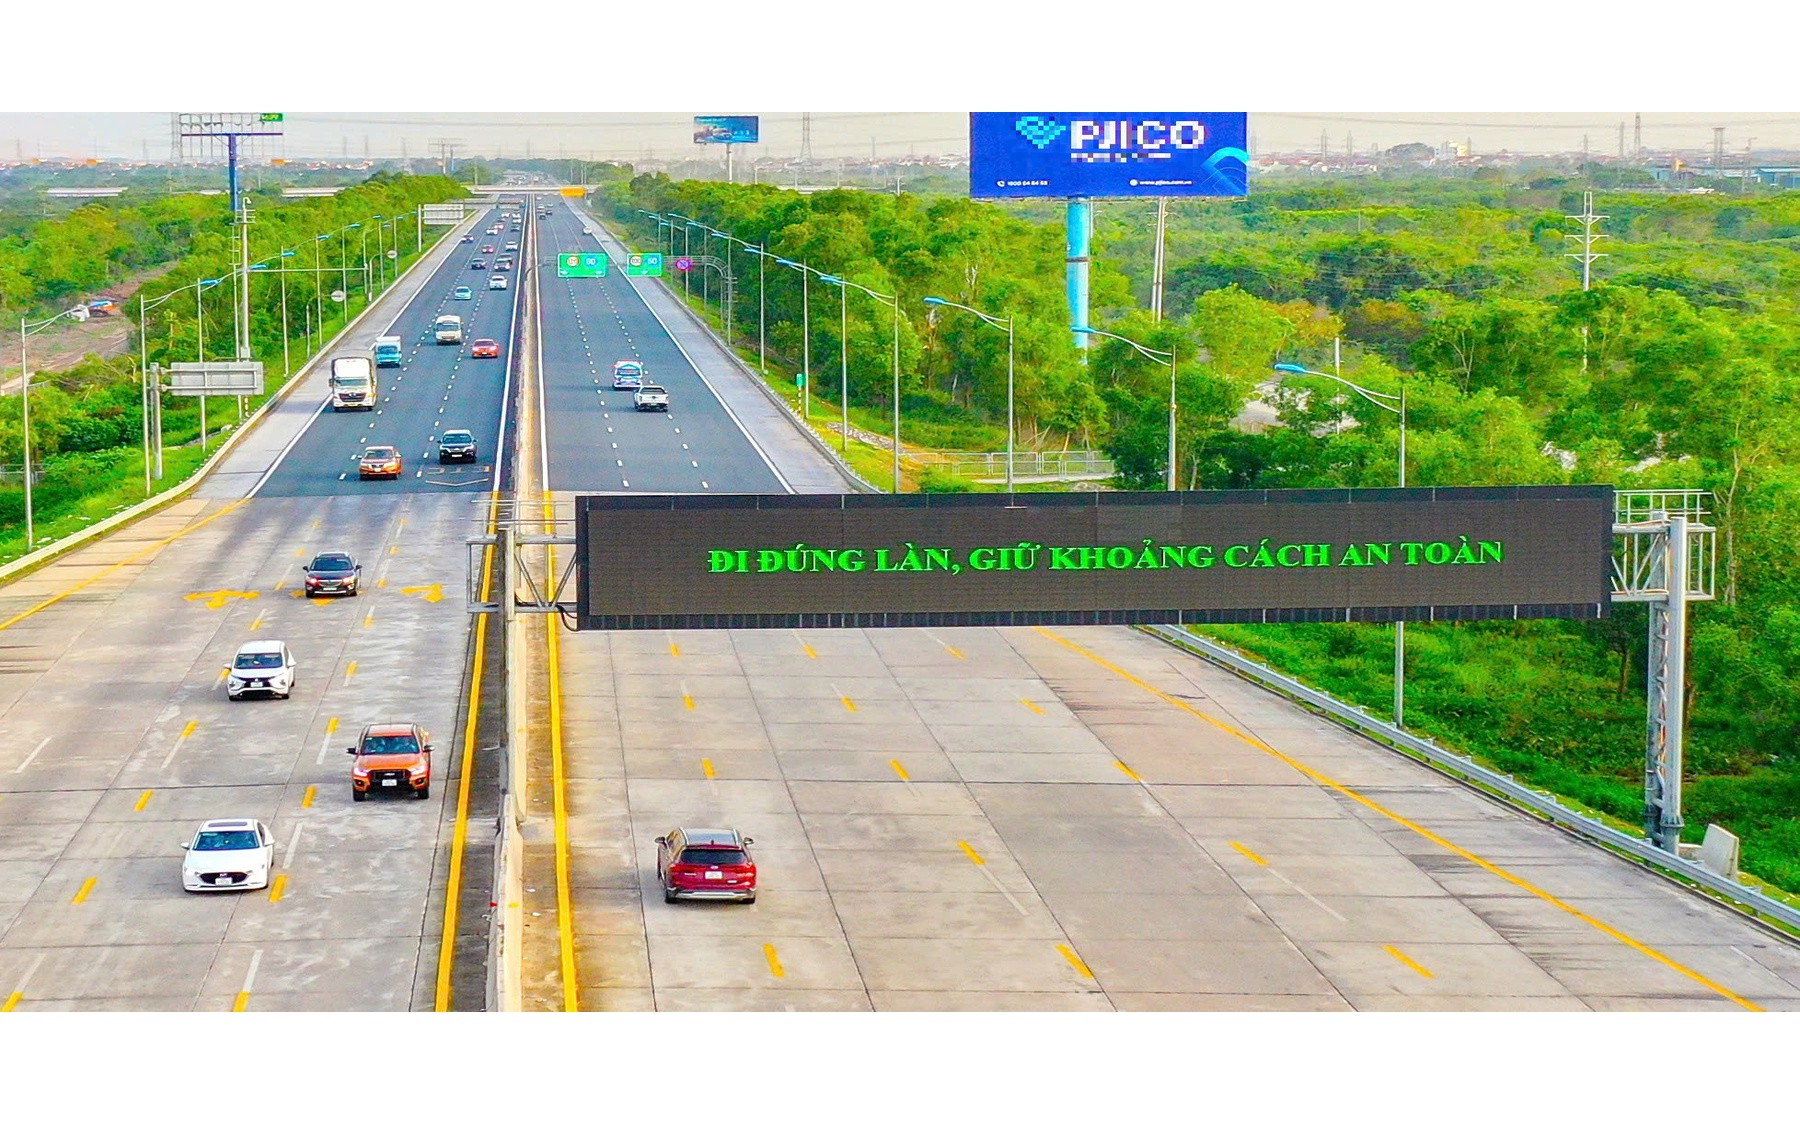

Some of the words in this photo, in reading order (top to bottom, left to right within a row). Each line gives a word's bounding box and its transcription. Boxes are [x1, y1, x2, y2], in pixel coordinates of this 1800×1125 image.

[1070, 120, 1205, 149] PJICO
[706, 549, 751, 573] ĐI
[756, 543, 866, 573] ĐÚNG
[873, 542, 962, 575] LÀN,
[968, 541, 1042, 571] GIỮ
[1047, 538, 1216, 571] KHOẢNG
[1223, 538, 1331, 568] CÁCH
[1338, 542, 1392, 567] AN
[1400, 535, 1504, 566] TOÀN
